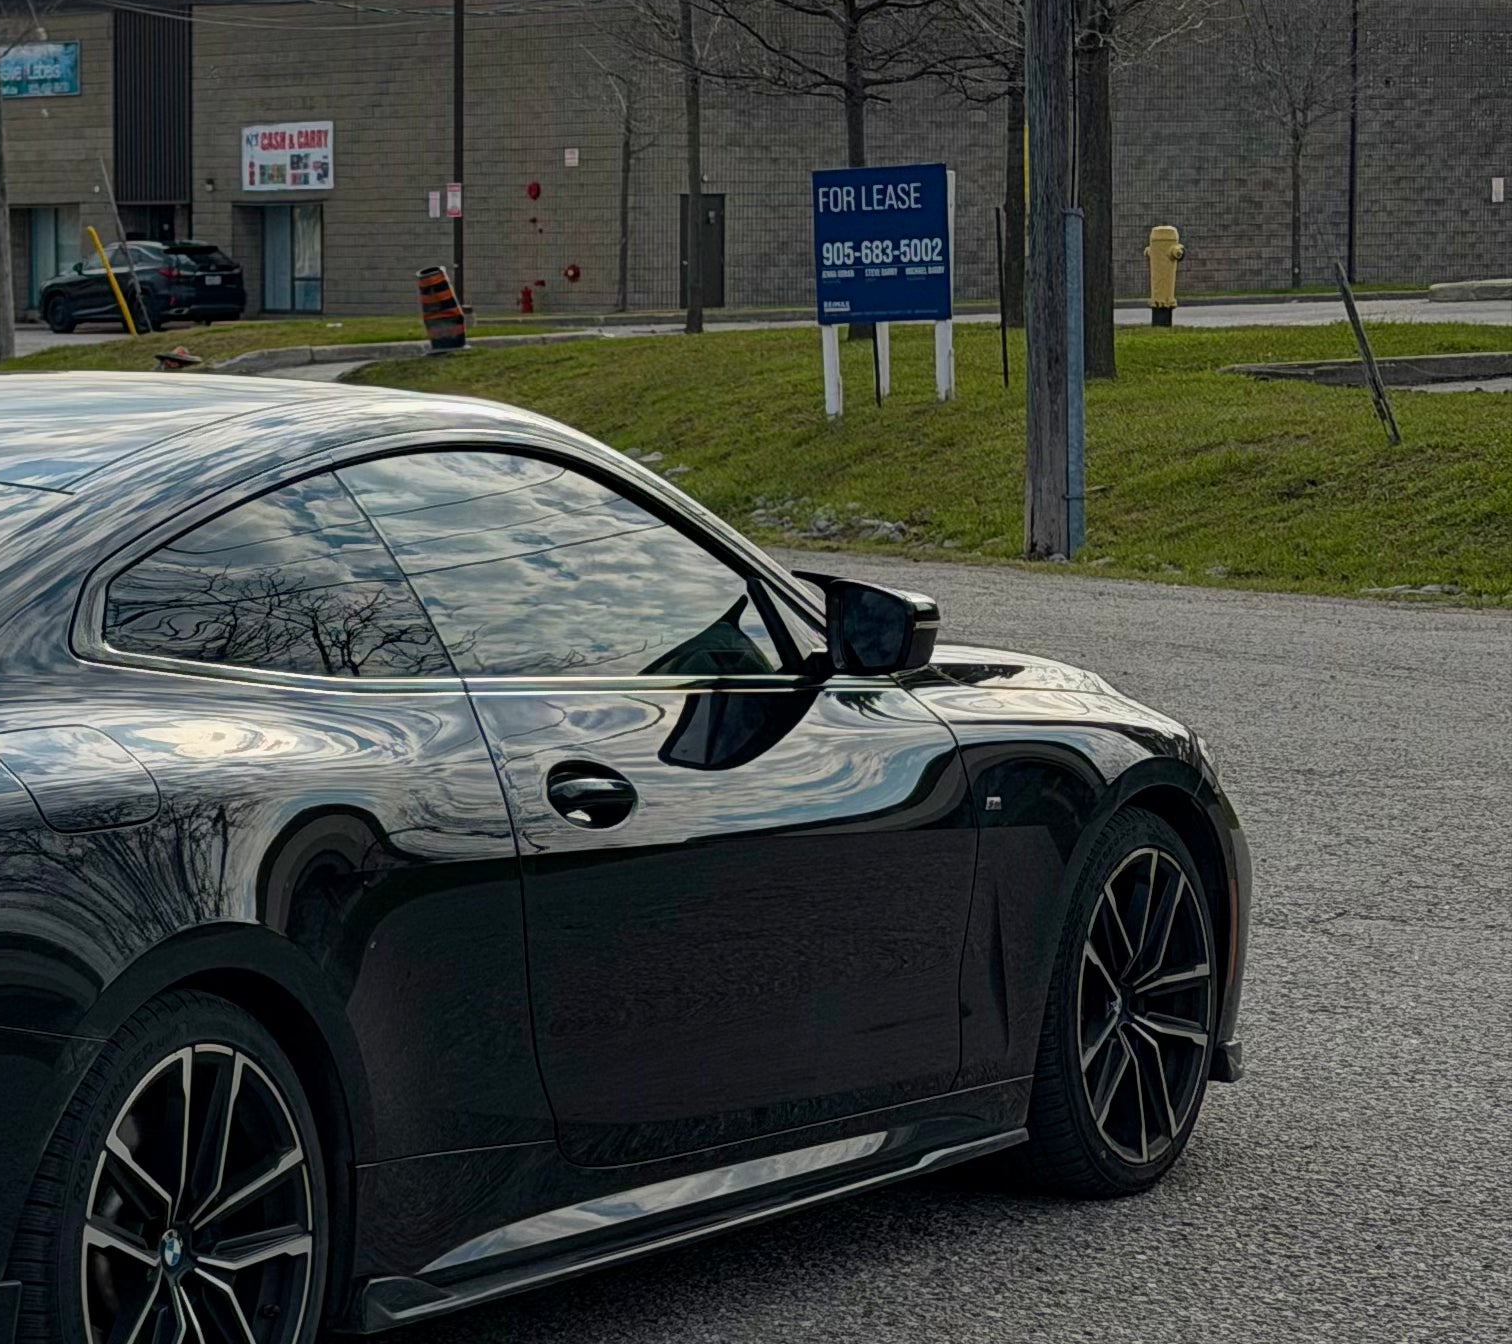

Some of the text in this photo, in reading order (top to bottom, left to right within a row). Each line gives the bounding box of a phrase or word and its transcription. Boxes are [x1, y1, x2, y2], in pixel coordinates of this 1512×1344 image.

[261, 132, 286, 151] CASH
[297, 130, 329, 149] CARRY
[818, 183, 922, 213] FOR LEASE
[822, 238, 943, 266] 905-683-5002
